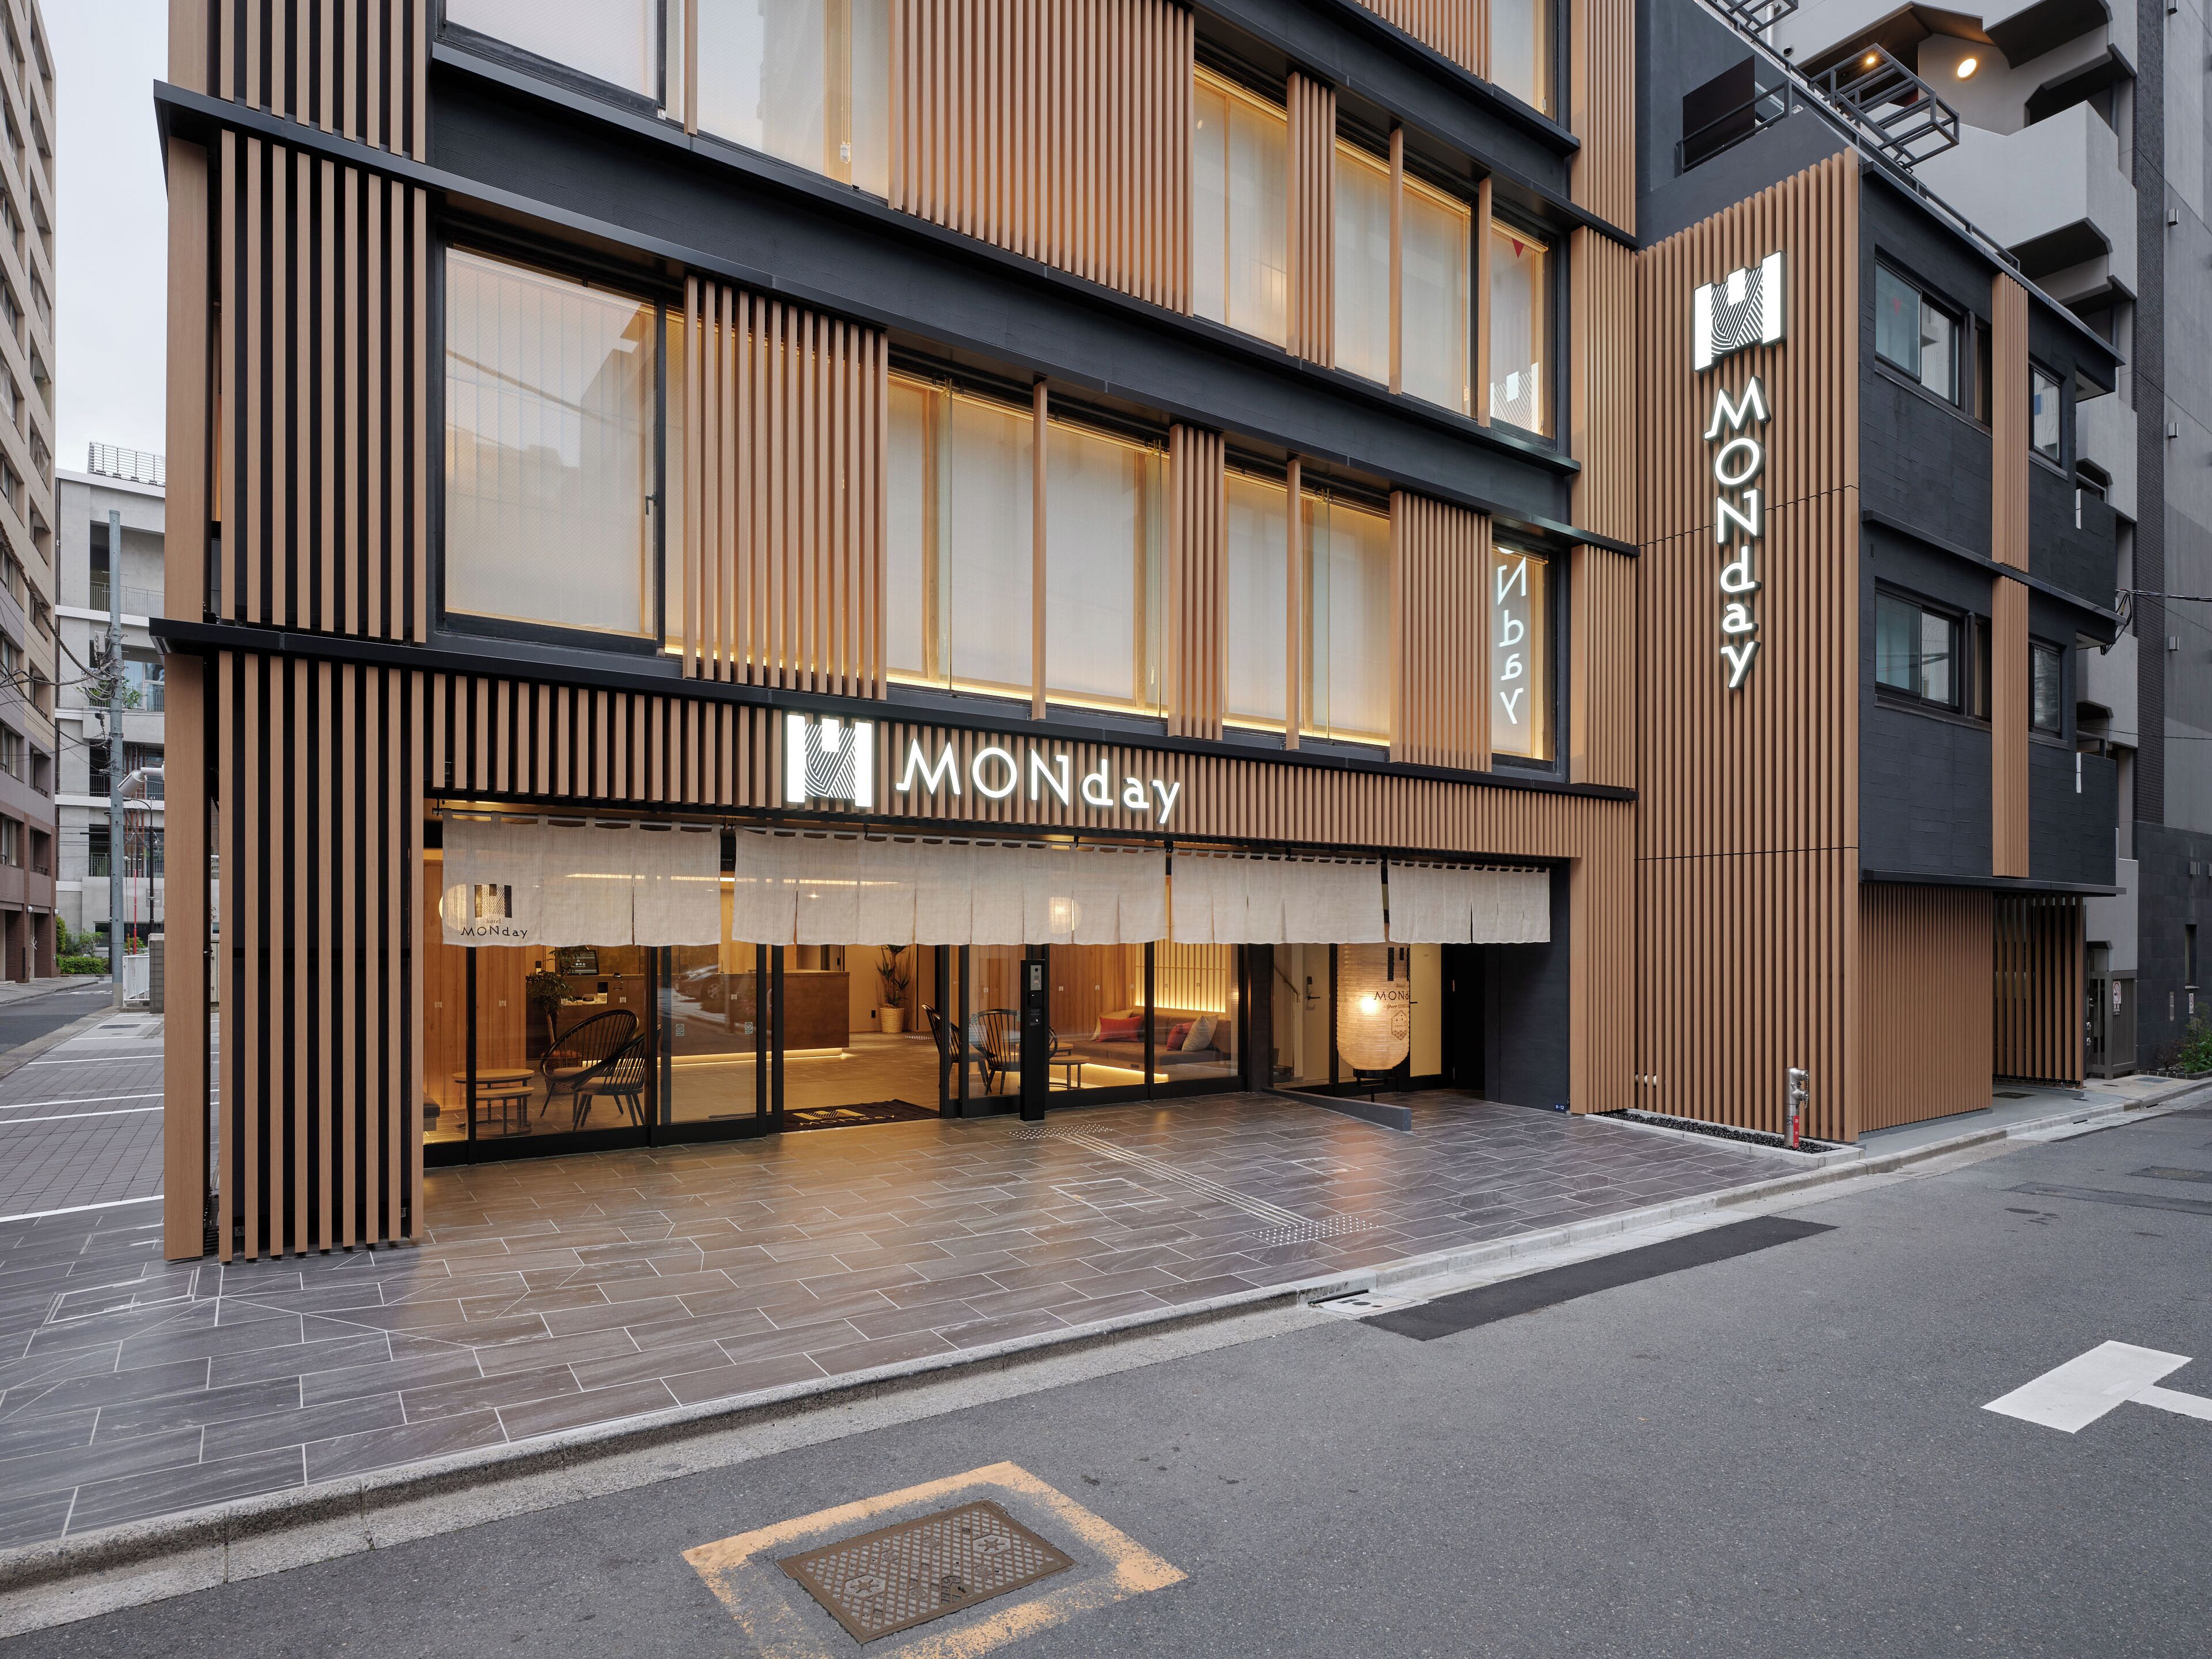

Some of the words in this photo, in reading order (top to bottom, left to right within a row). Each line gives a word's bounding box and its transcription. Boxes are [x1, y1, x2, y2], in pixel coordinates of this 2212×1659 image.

[1704, 376, 1767, 689] MONday
[895, 737, 1180, 824] MONday
[460, 926, 528, 939] MONday
